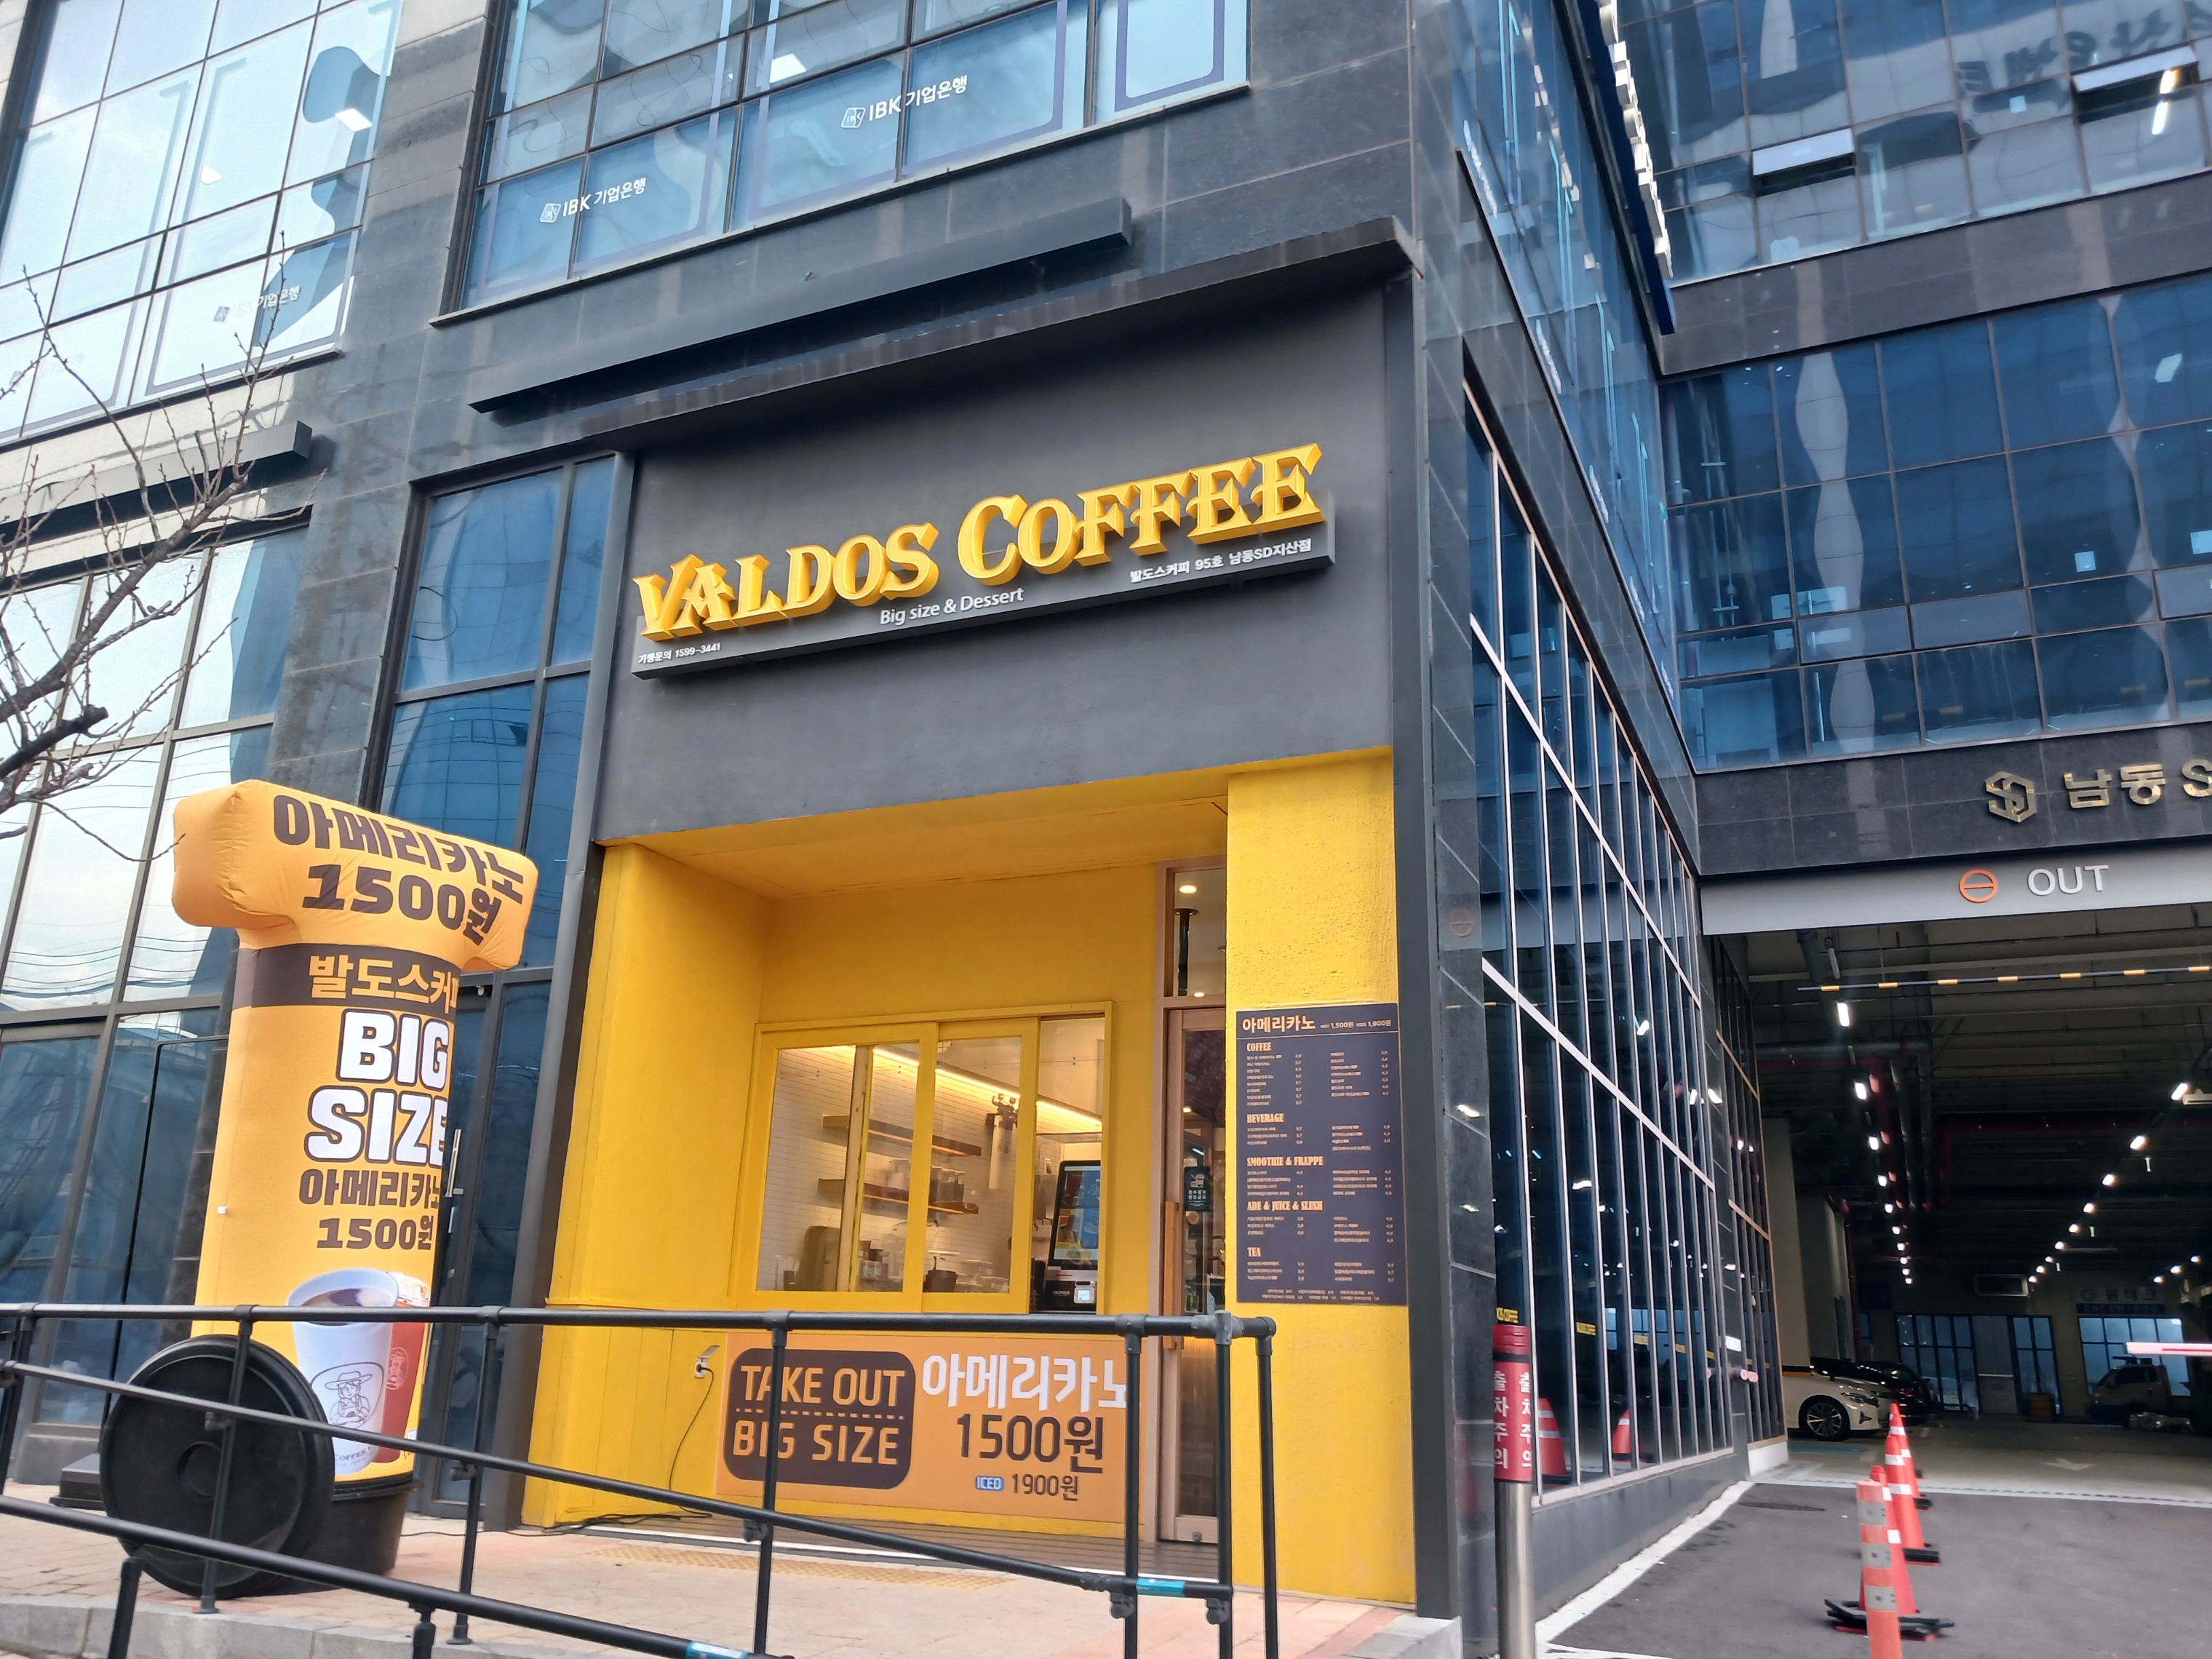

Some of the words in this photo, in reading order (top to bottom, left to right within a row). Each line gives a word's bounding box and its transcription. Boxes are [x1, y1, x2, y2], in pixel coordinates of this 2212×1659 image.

[869, 95, 902, 121] IBK
[906, 75, 968, 106] 기업은행
[563, 194, 592, 217] IBK
[593, 178, 647, 205] 기업은행
[633, 521, 939, 642] VALDOS
[957, 442, 1326, 586] COFFEE
[1130, 560, 1190, 584] 발도스커피
[1195, 555, 1224, 571] 95호
[1229, 538, 1312, 566] 남동SD지산점
[880, 609, 906, 626] Big
[910, 604, 941, 620] size
[943, 598, 958, 613] &
[960, 587, 1025, 611] Dessert
[675, 642, 721, 659] 1599-3441
[2063, 763, 2168, 809] 남동
[272, 794, 525, 905] 아메리카노
[2027, 864, 2109, 896] OUT
[301, 863, 503, 945] 1500원
[1242, 1014, 1316, 1034] 아메리카노
[335, 1008, 451, 1091] BIG
[1246, 1041, 1272, 1052] COFFEE
[304, 1085, 448, 1168] SIZE
[1246, 1113, 1284, 1123] BEVERAGE
[1246, 1156, 1284, 1167] SMOOTHIE
[1285, 1156, 1293, 1166] &
[1294, 1155, 1324, 1166] FRAPPE
[1247, 1201, 1262, 1212] ADE
[1262, 1201, 1270, 1211] &
[1271, 1200, 1291, 1212] JUICE
[1292, 1201, 1300, 1211] &
[317, 1214, 434, 1250] 1500원
[1247, 1246, 1262, 1257] TEA
[740, 1364, 824, 1404] TAKE
[832, 1367, 906, 1407] OUT
[921, 1353, 1128, 1413] 아메리카노
[733, 1420, 796, 1460] BIG
[811, 1423, 900, 1465] SIZE
[956, 1413, 1104, 1474] 1500원
[976, 1476, 1003, 1490] ICED
[1011, 1473, 1078, 1502] 1900원
